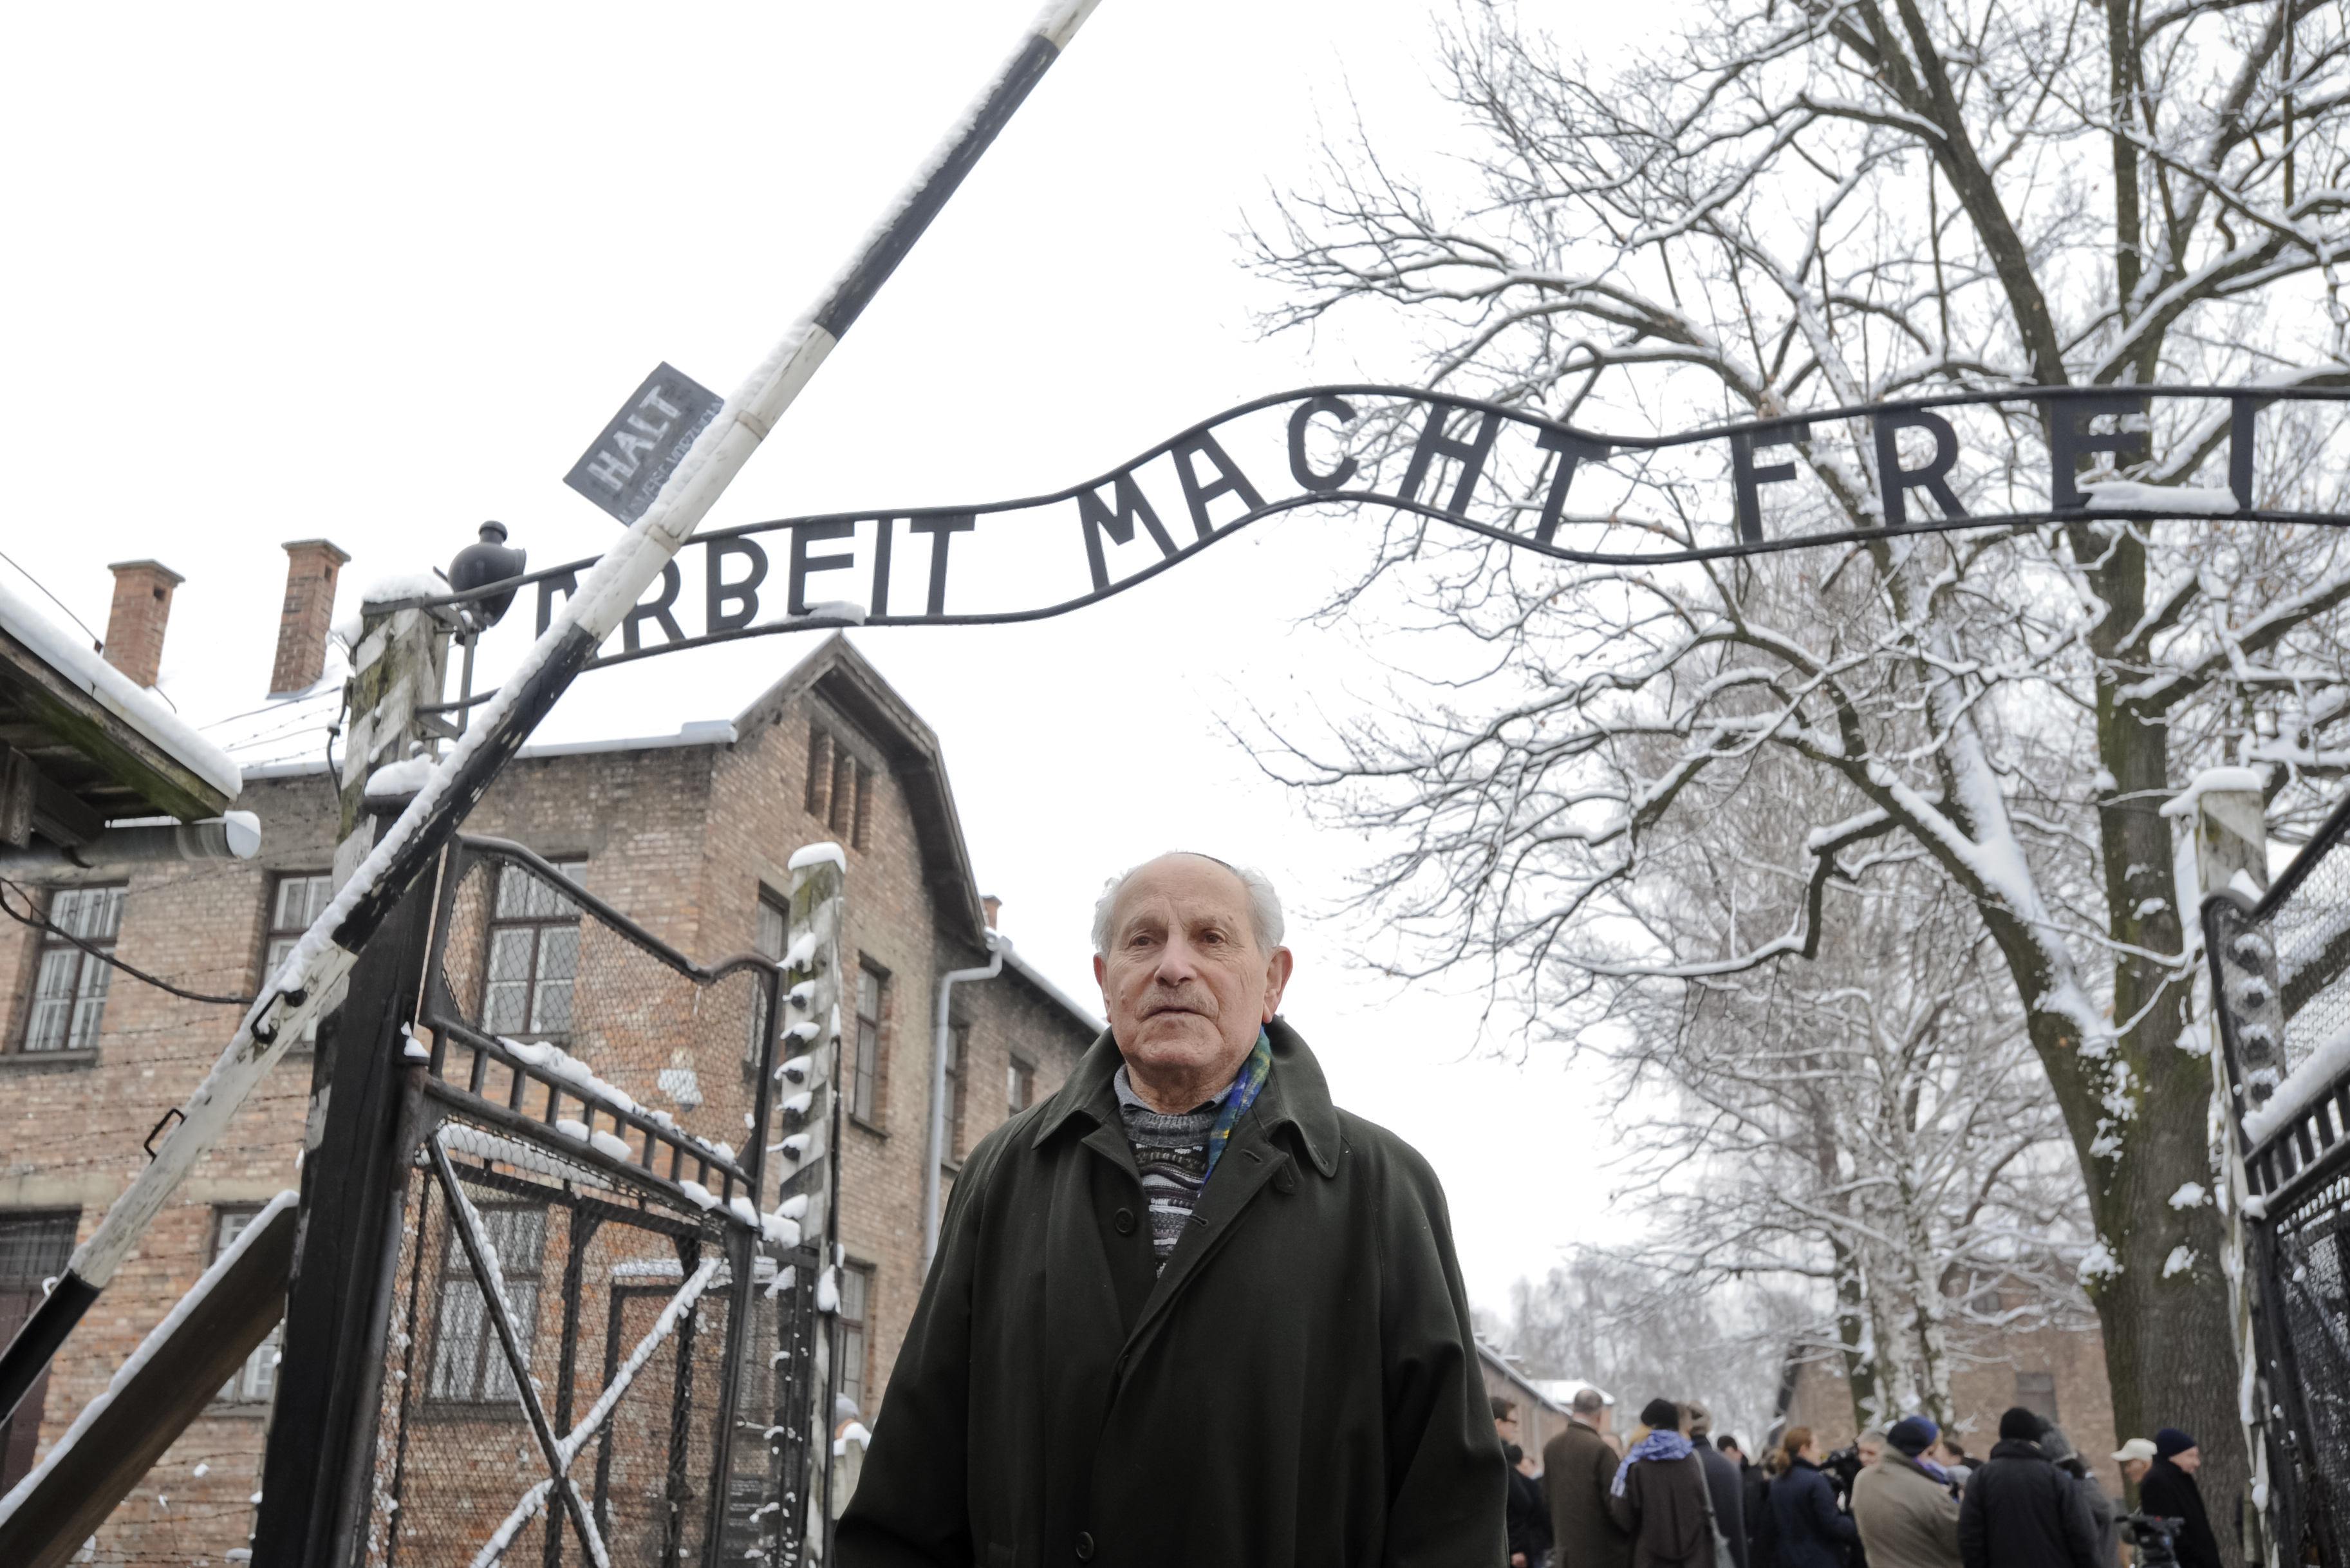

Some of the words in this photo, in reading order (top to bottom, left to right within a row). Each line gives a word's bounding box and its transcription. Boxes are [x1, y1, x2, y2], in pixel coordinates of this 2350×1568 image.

[586, 384, 681, 491] HALT
[1077, 395, 1610, 593] MACHT
[1730, 397, 2255, 542] FREI
